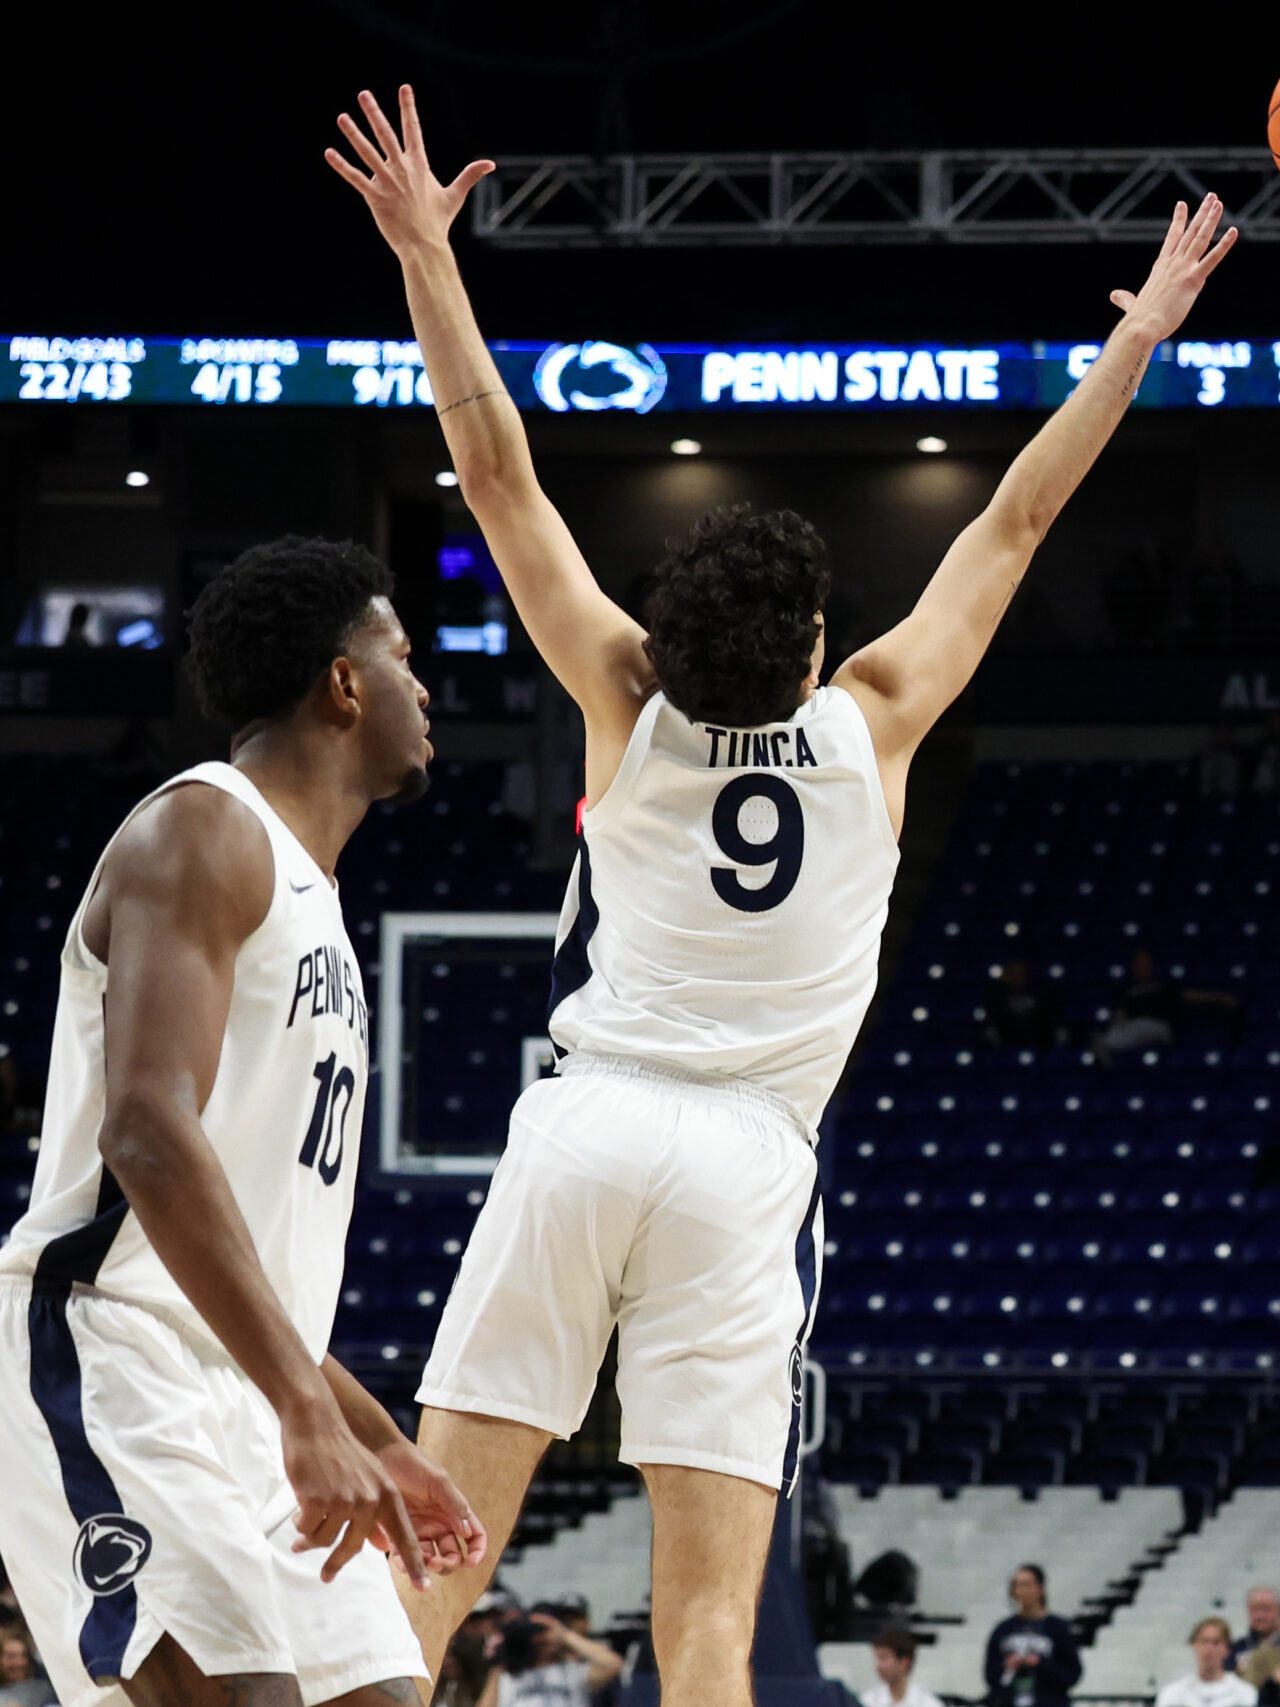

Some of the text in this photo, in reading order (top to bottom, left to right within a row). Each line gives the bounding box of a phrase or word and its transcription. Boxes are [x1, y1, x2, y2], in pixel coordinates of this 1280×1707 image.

[19, 361, 132, 402] 22/43
[191, 362, 282, 404] 4/15
[702, 350, 999, 402] PENN STATE
[1197, 366, 1226, 406] 3
[710, 773, 804, 912] 9
[298, 1050, 355, 1187] 10
